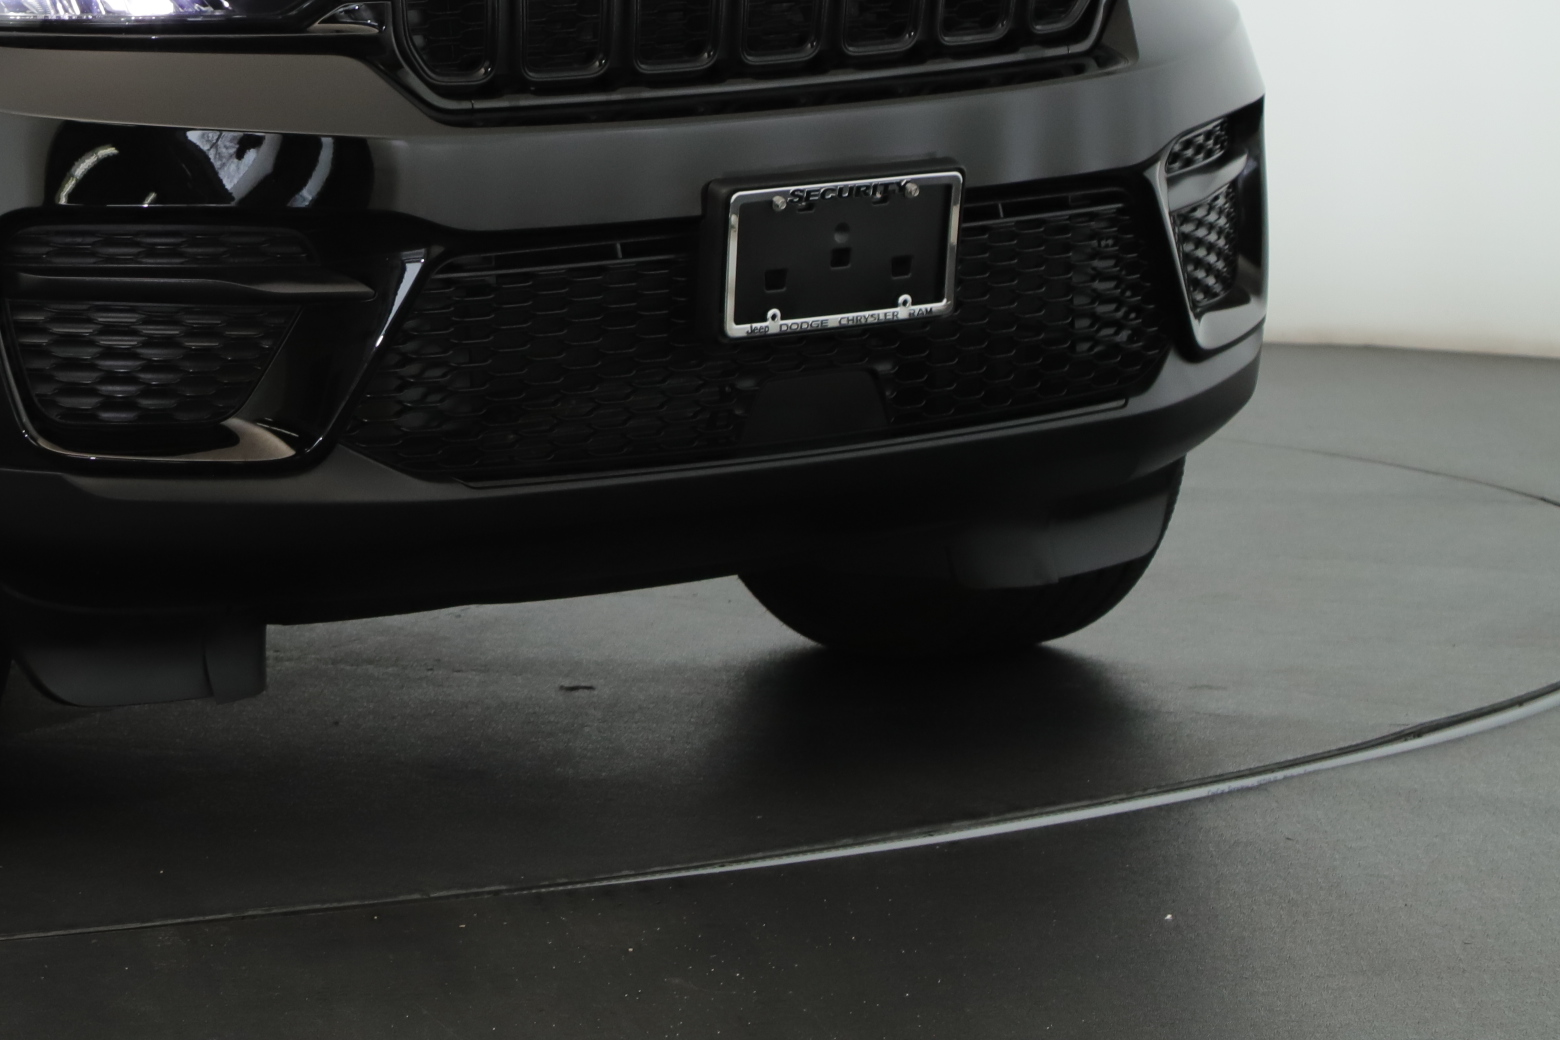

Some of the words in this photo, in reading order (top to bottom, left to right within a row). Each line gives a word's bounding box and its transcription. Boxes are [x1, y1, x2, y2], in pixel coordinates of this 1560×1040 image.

[788, 179, 912, 203] SECURITY
[746, 324, 770, 336] Jeep
[779, 319, 829, 332] DODGE
[838, 310, 900, 326] CHRYSLER
[908, 307, 934, 318] RAM
